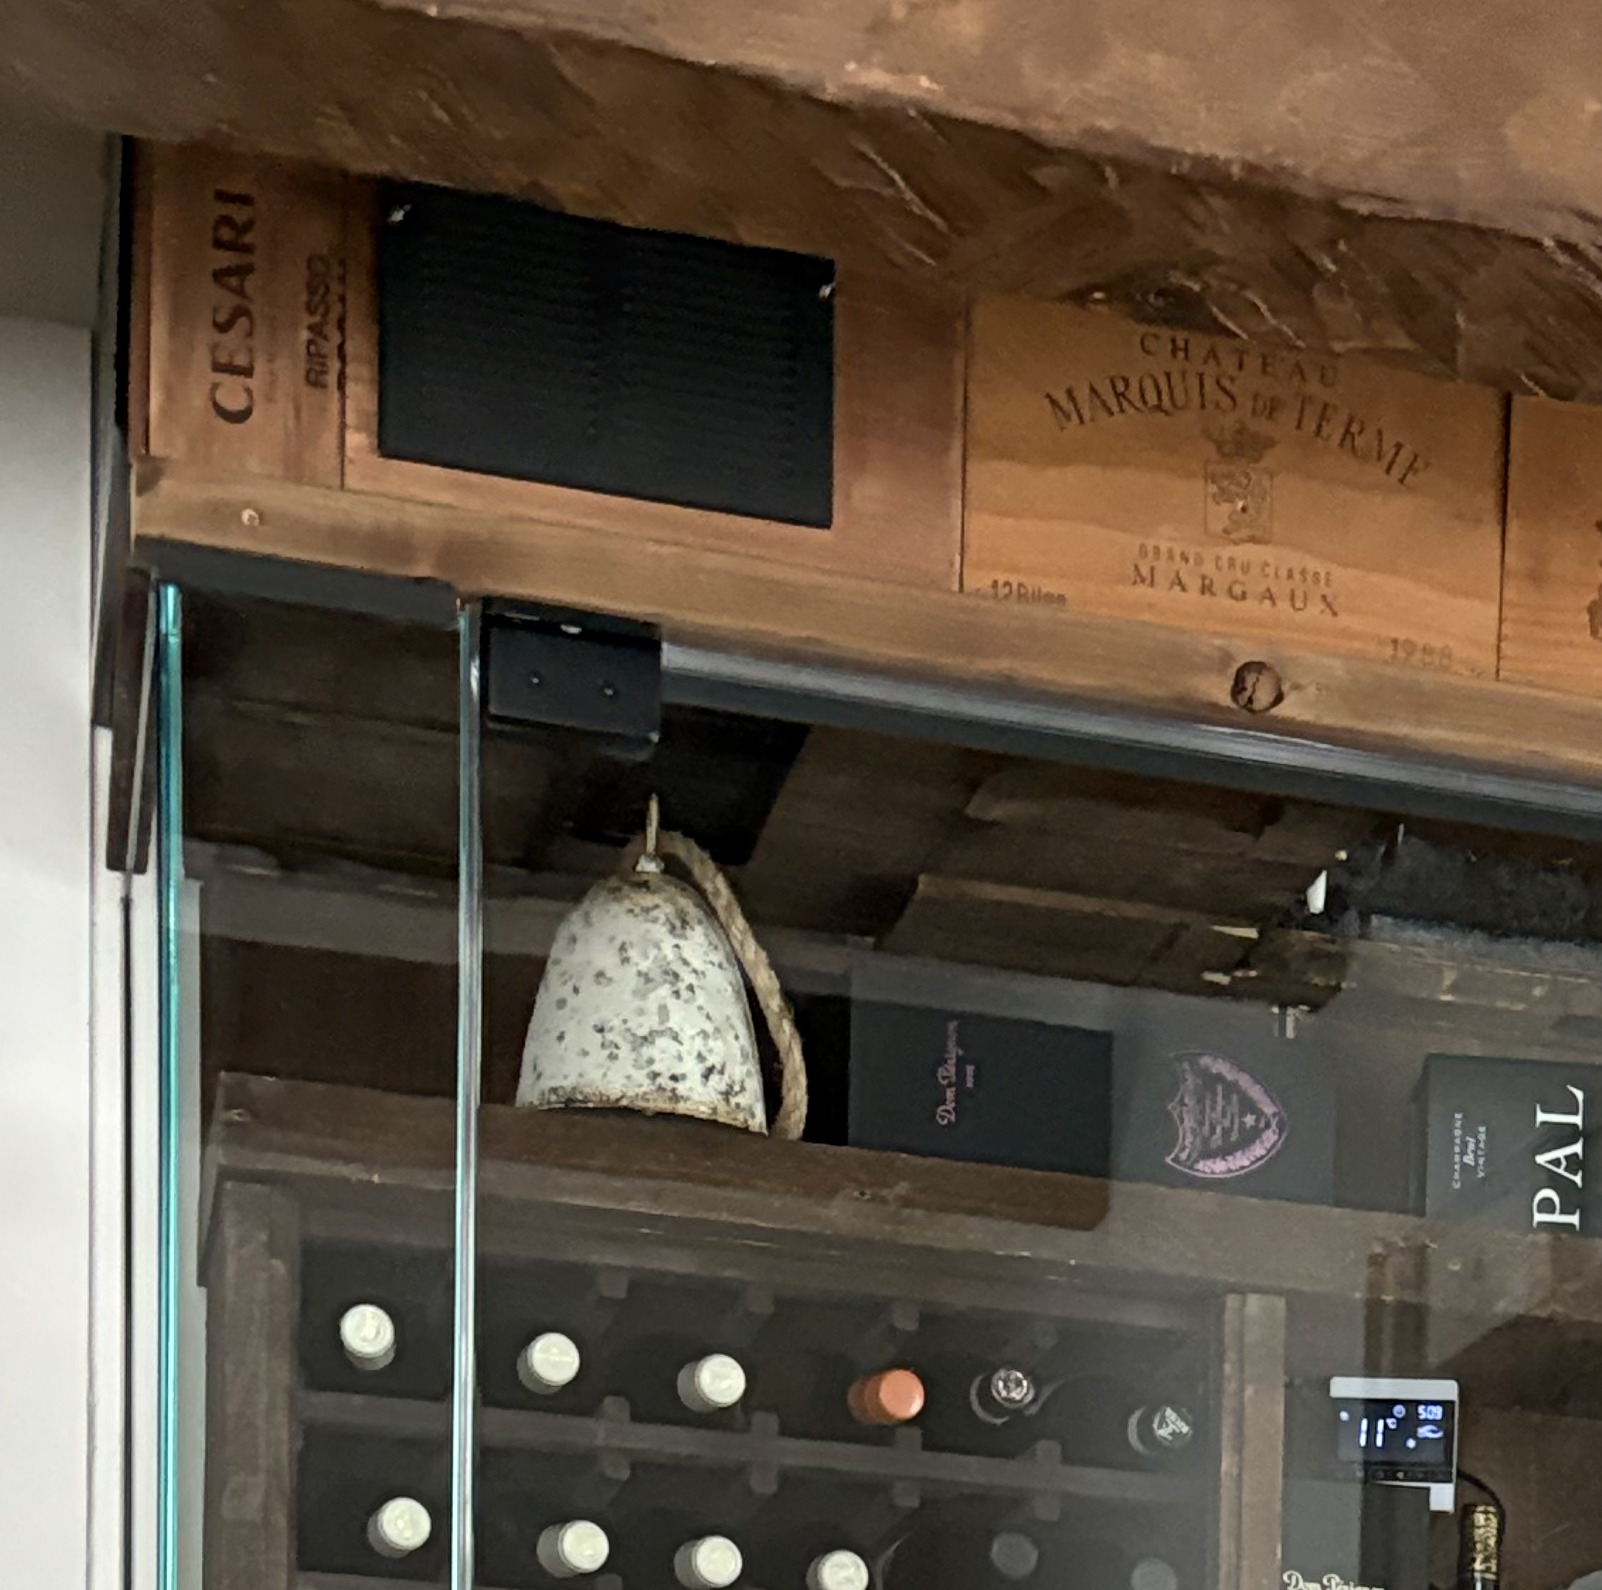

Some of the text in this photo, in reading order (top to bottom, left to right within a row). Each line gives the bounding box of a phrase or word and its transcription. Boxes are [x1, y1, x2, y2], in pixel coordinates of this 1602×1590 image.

[210, 188, 255, 424] CESARI
[305, 254, 330, 388] RIPASSO
[1045, 368, 1238, 432] MARQUIS
[1295, 394, 1432, 487] TERME
[1131, 562, 1340, 618] MARGAUX
[1214, 554, 1251, 576] CRU
[1452, 1112, 1463, 1190] CHAMPAGNE
[1463, 1135, 1477, 1167] Brut
[1476, 1124, 1488, 1179] VINTAGE
[1532, 1084, 1587, 1232] PAL
